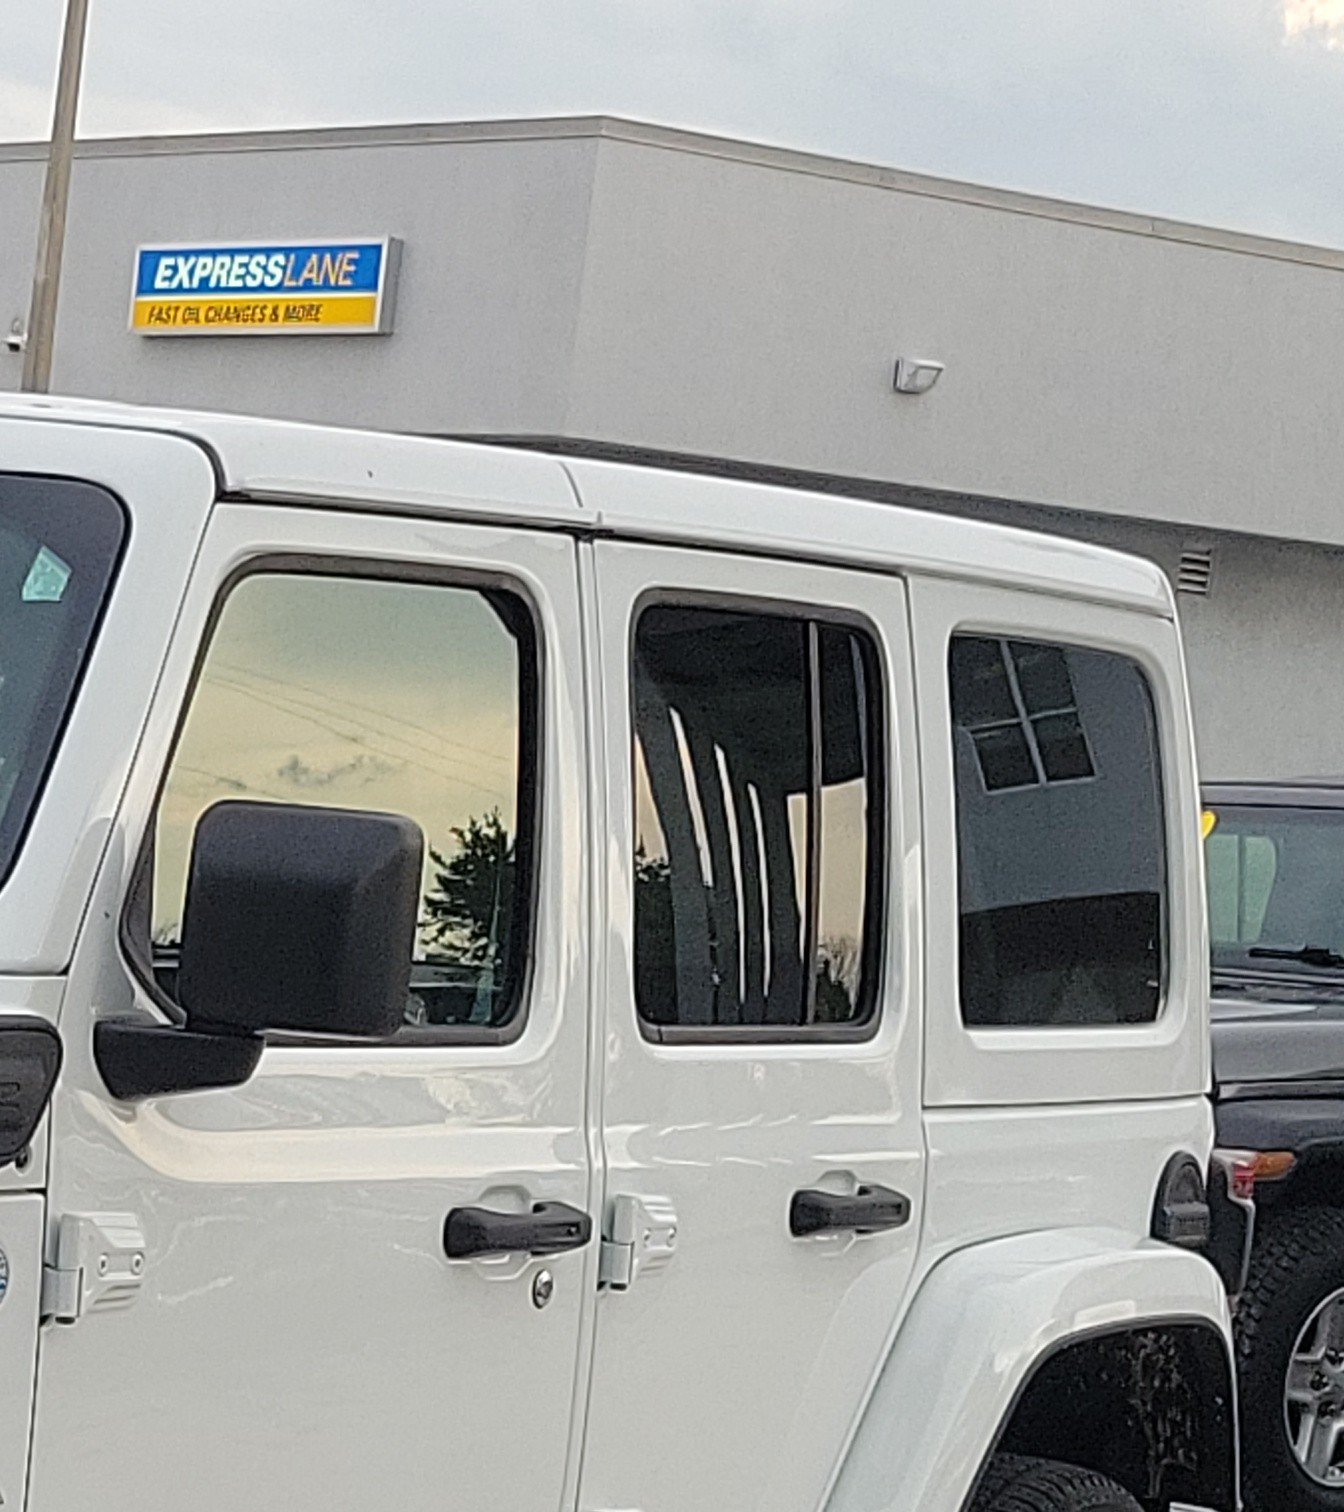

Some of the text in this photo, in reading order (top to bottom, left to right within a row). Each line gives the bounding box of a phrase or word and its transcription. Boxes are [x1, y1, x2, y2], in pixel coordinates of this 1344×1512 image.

[147, 304, 180, 325] FAST
[204, 303, 267, 323] CHANGES
[269, 303, 279, 323] &
[282, 302, 323, 322] MORE
